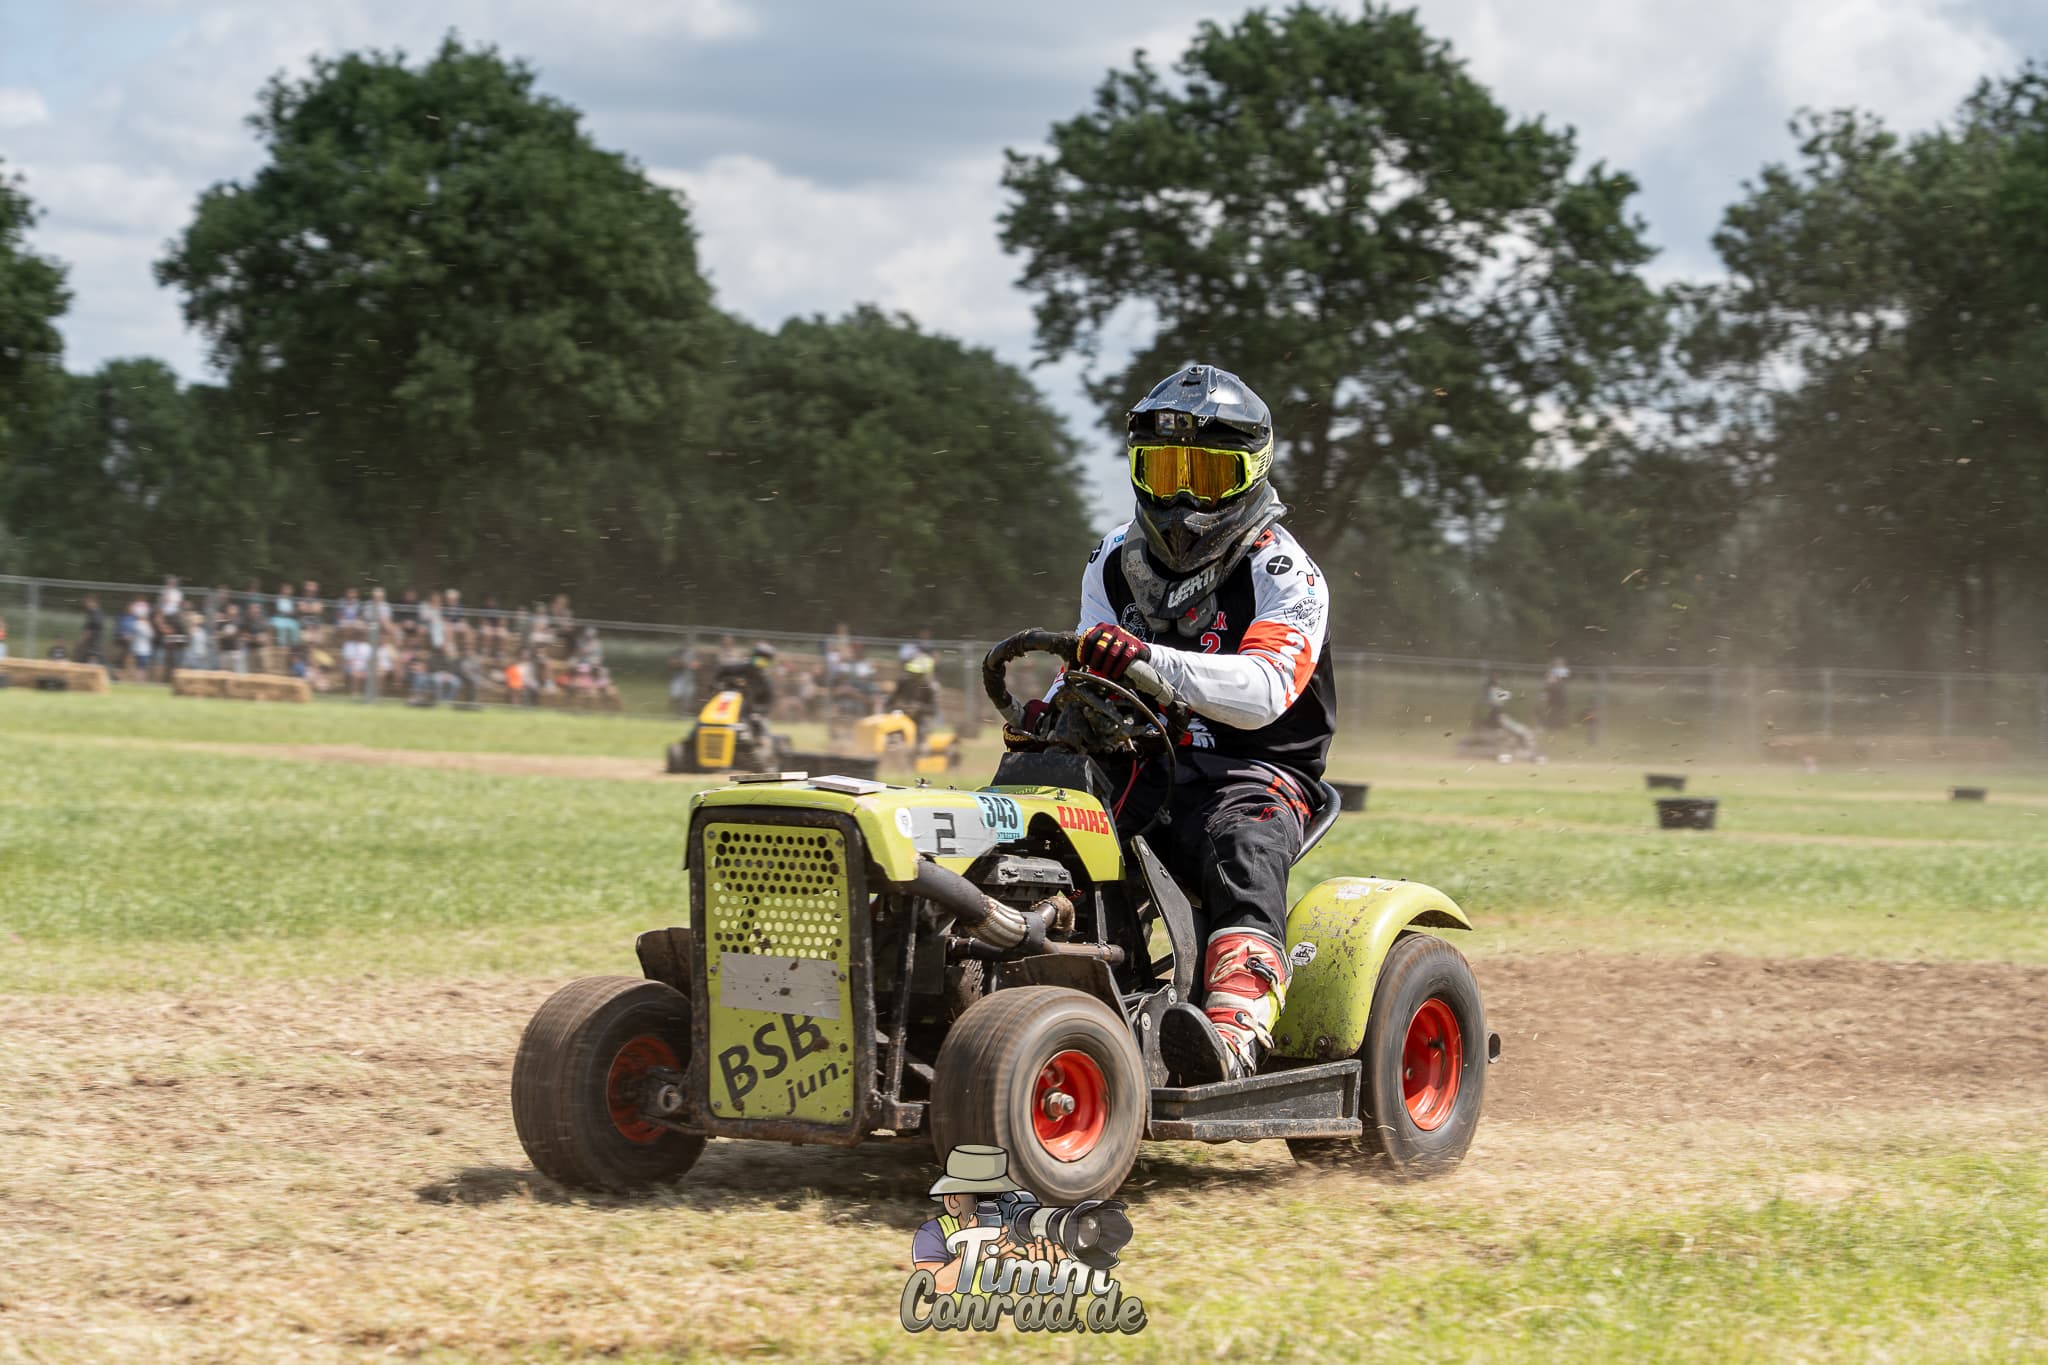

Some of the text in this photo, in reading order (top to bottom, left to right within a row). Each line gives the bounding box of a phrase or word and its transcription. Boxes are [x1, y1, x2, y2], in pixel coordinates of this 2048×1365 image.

[933, 812, 957, 855] 2
[978, 796, 1018, 829] 343
[1056, 805, 1110, 835] CLAAS
[718, 1013, 823, 1104] BSB
[785, 1062, 849, 1116] jun.
